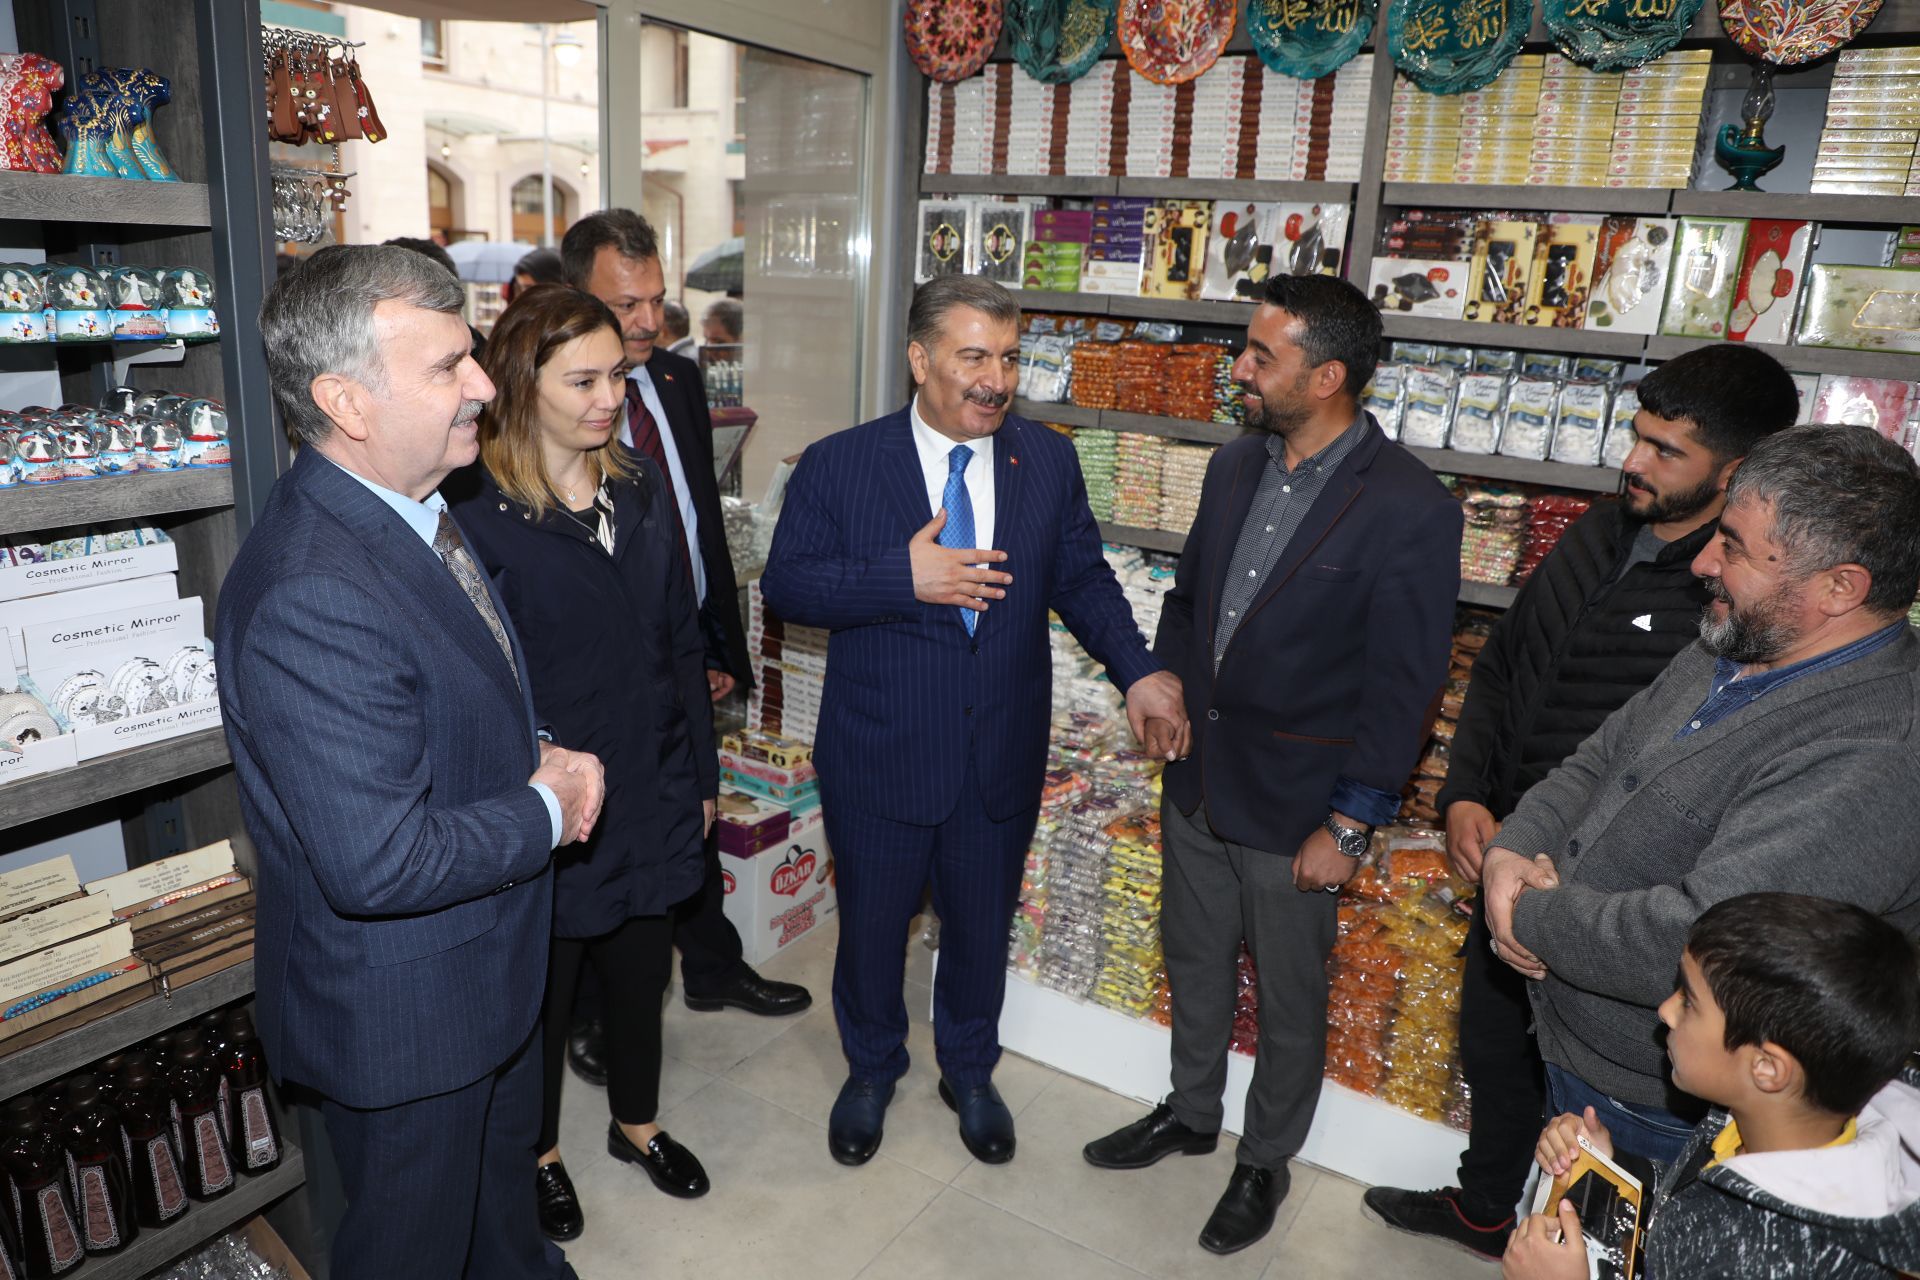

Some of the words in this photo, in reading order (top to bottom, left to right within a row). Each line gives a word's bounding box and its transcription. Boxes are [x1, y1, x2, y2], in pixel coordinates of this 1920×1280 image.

[26, 563, 87, 579] Cosmetic
[91, 556, 134, 569] Mirror
[51, 623, 125, 643] Cosmetic
[130, 613, 181, 629] Mirror
[114, 718, 173, 735] Cosmetic
[177, 705, 219, 720] Mirror
[776, 861, 813, 891] ÖZKAR
[168, 916, 199, 929] YILDIZ
